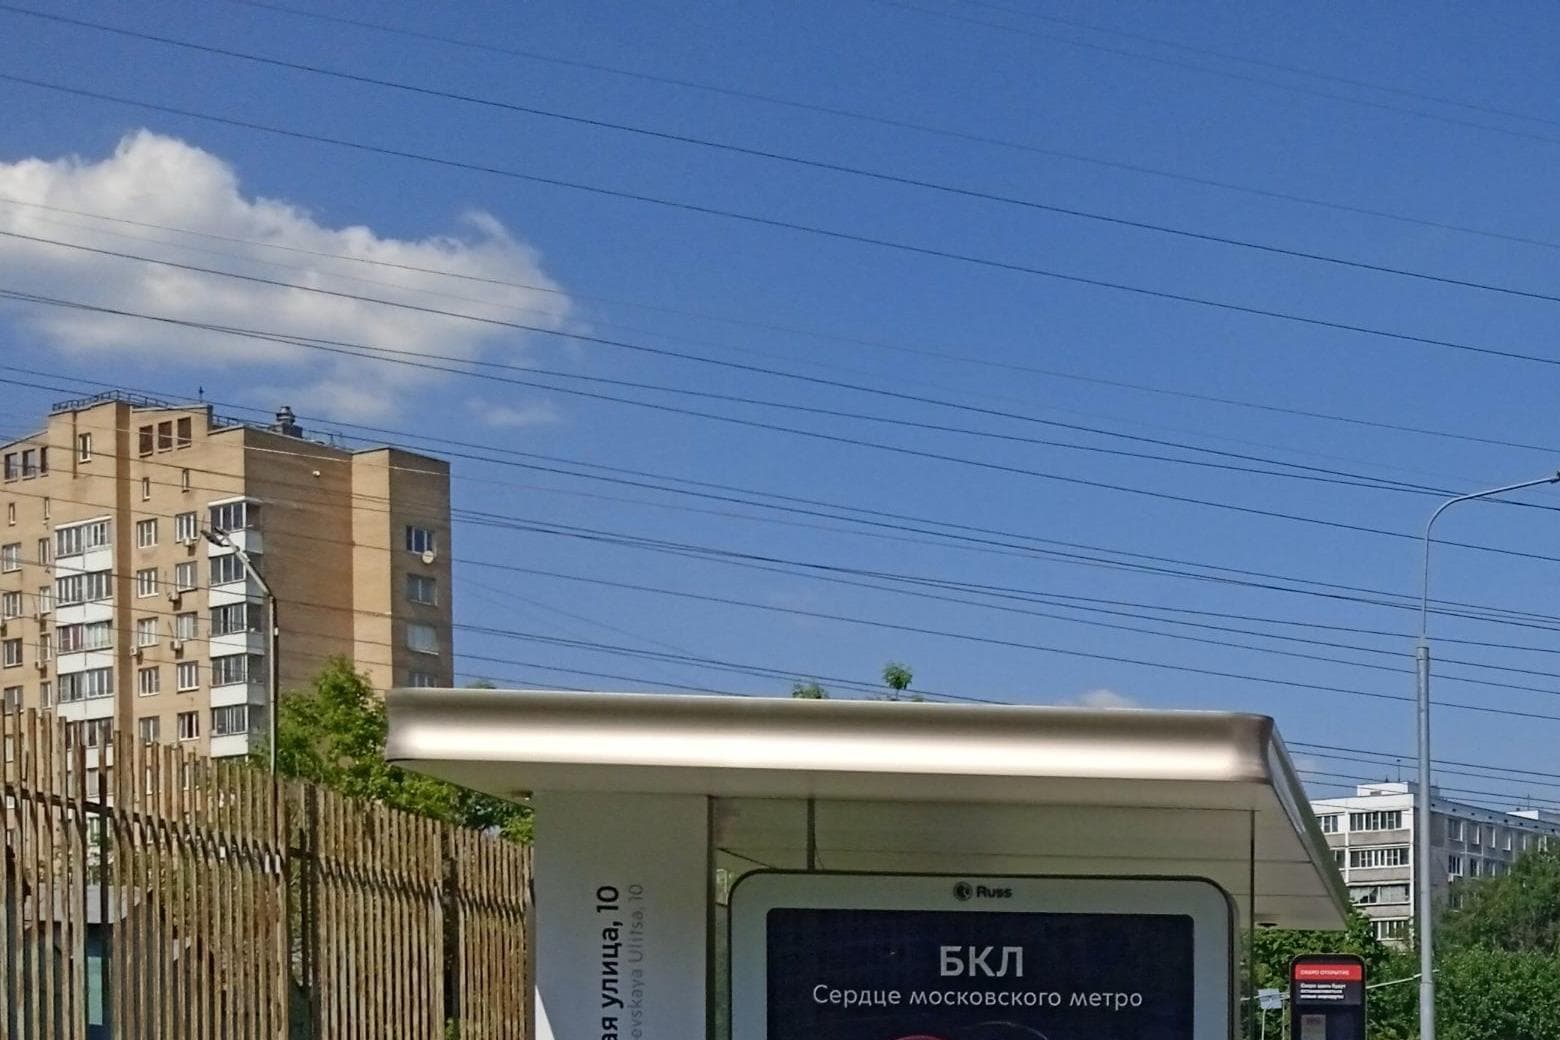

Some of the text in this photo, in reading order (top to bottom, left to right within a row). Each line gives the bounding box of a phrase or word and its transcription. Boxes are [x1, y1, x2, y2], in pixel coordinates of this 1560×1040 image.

[596, 885, 619, 913] 10
[628, 884, 644, 901] 10
[976, 885, 1012, 898] Russ
[602, 920, 623, 1009] улица,
[940, 946, 1024, 978] БКЛ
[812, 984, 1143, 1010] Сердце московского метро
